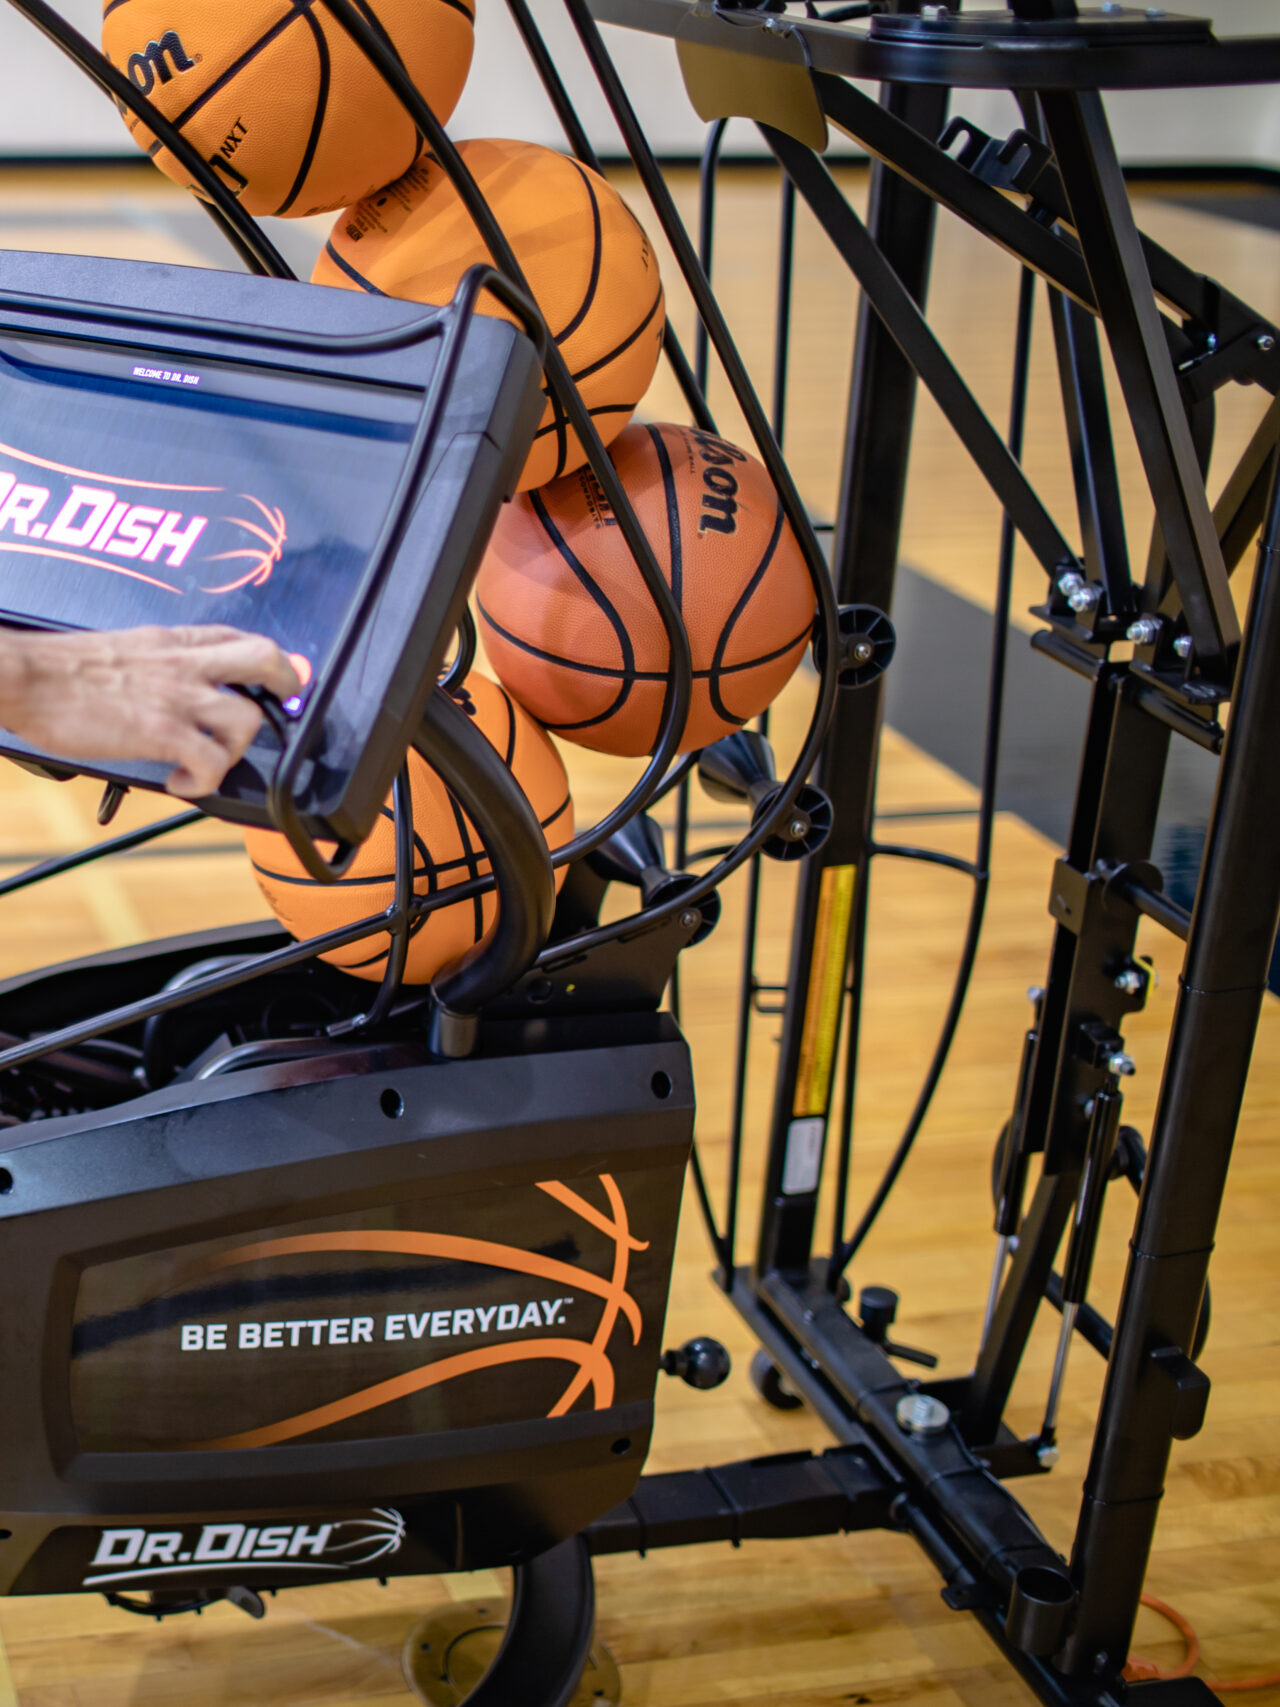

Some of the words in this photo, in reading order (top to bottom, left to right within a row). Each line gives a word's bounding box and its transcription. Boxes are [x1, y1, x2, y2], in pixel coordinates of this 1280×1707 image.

[220, 116, 248, 159] NXT
[133, 367, 163, 379] WELCOME
[163, 371, 171, 381] TO
[171, 372, 182, 383] DR.
[183, 374, 200, 385] DISH
[181, 1323, 227, 1351] BE
[238, 1316, 375, 1349] BETTER
